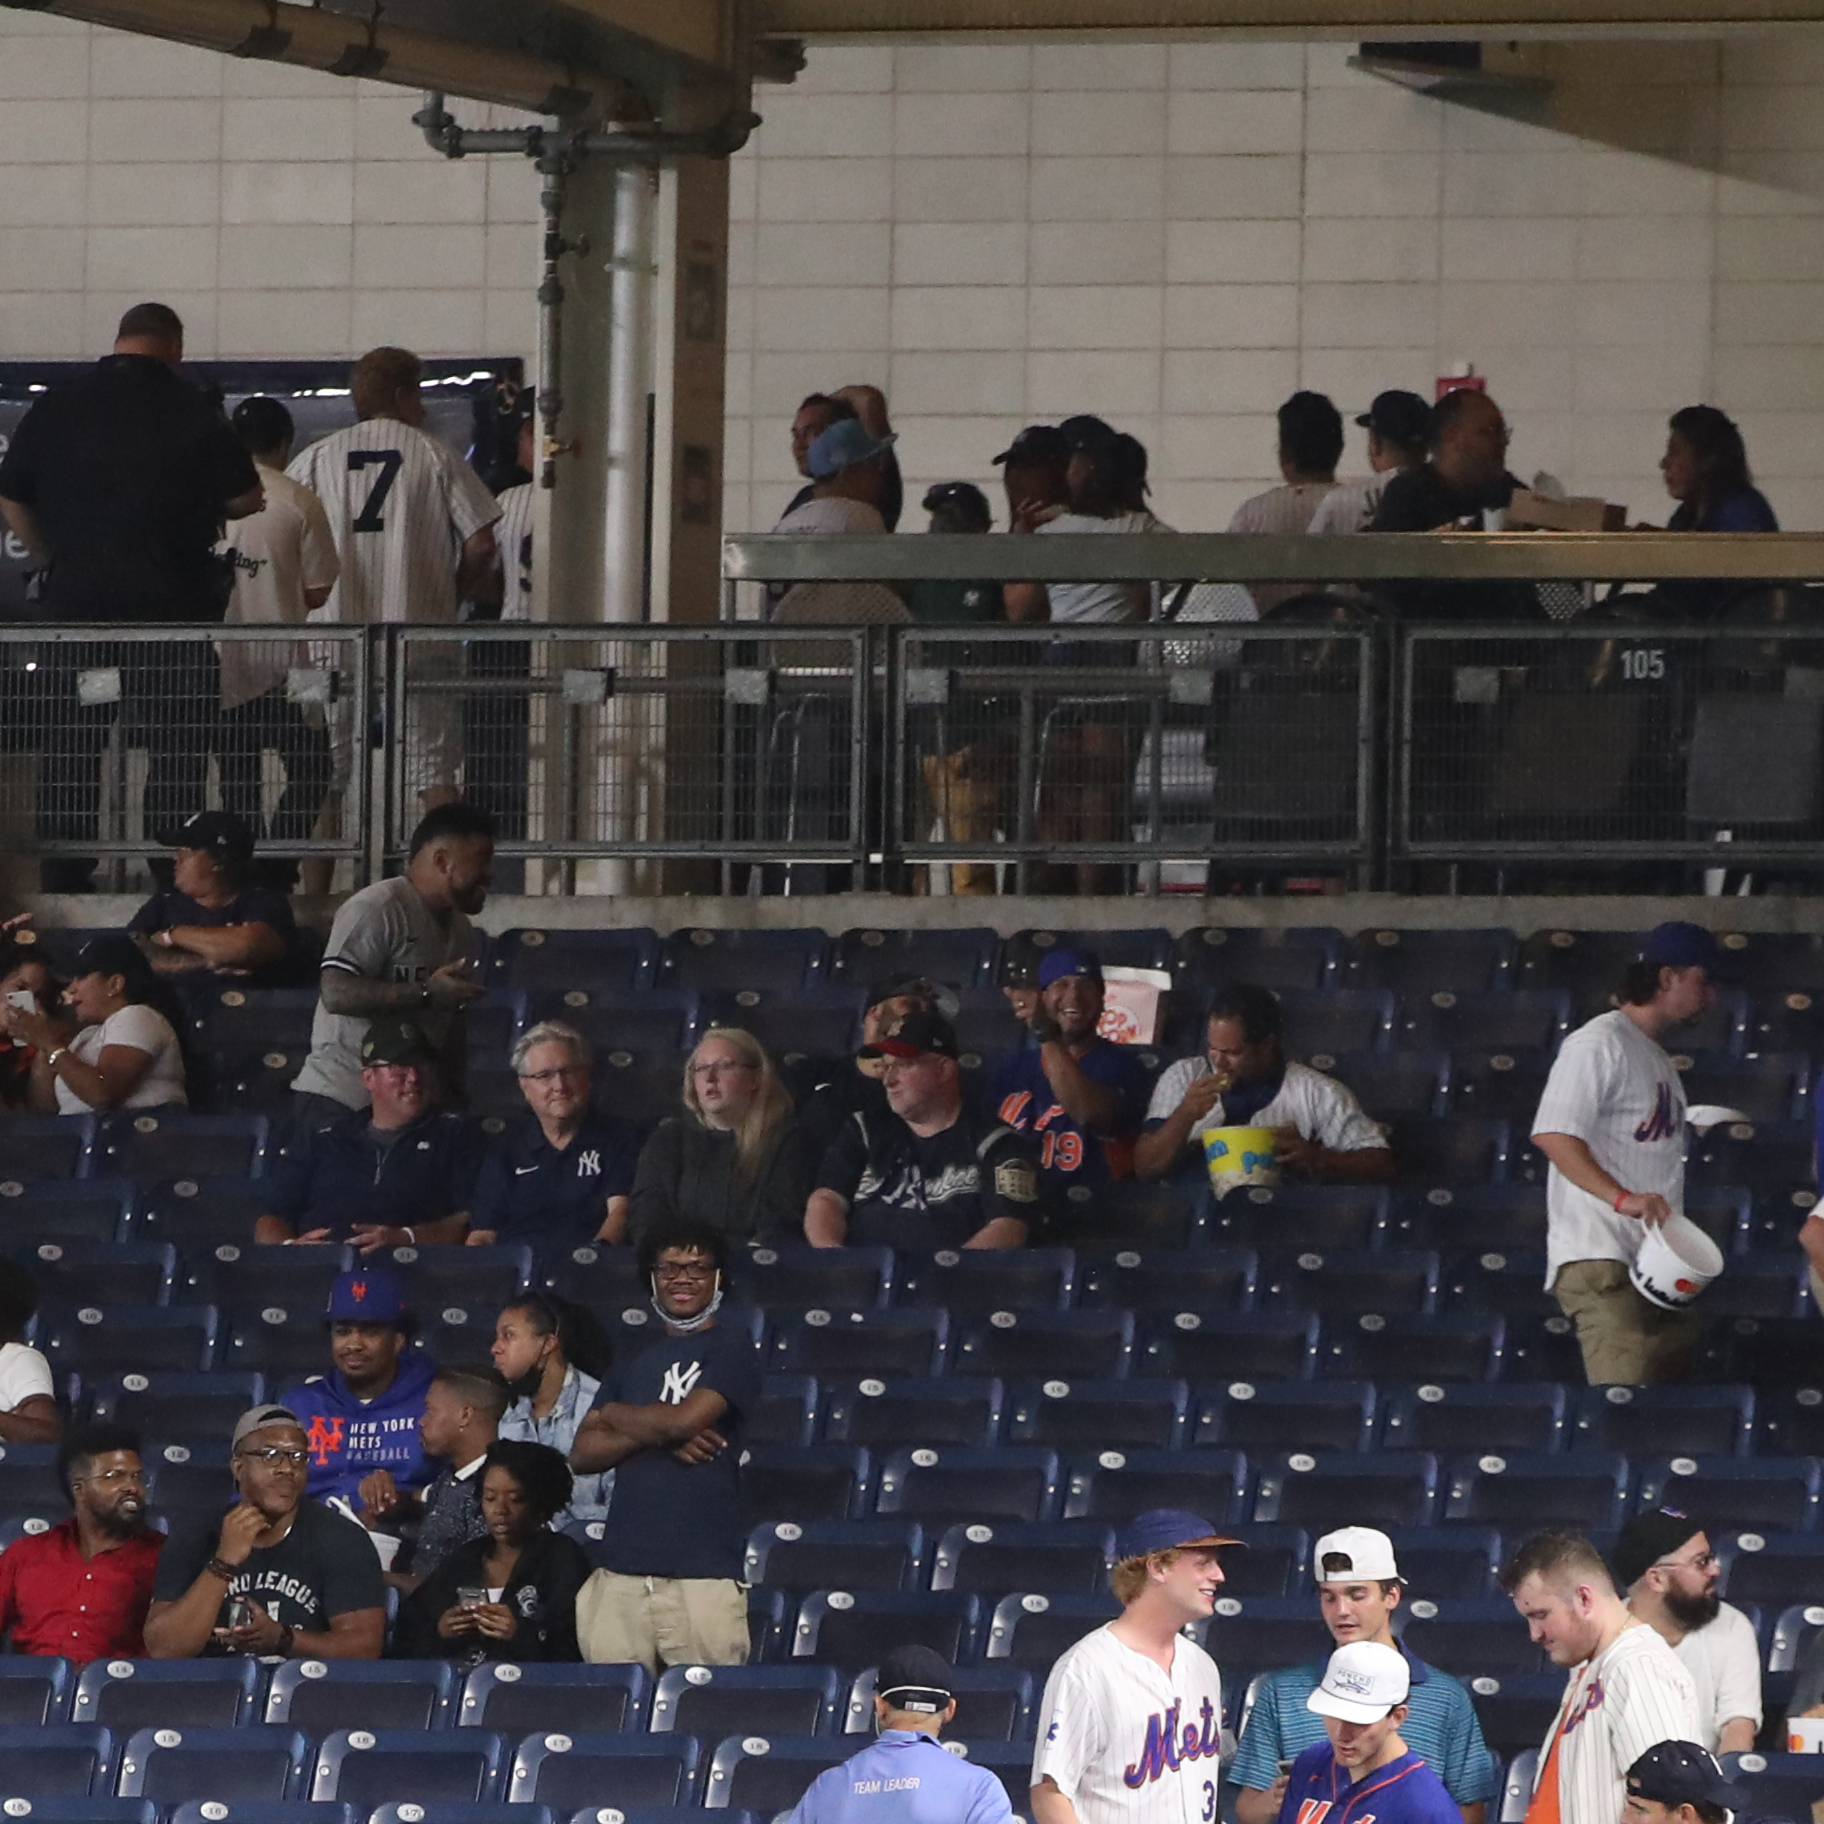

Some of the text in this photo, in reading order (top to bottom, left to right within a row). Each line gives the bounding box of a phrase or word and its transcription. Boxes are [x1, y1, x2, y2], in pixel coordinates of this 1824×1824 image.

[347, 449, 404, 533] 7
[1619, 649, 1665, 680] 105
[1040, 1131, 1084, 1171] 19
[658, 1361, 703, 1405] NY
[349, 1417, 416, 1437] NEW YORK
[348, 1436, 382, 1450] METS
[254, 1570, 320, 1615] LEAGUE
[1337, 1668, 1372, 1687] PONCHO
[853, 1776, 921, 1795] TEAM LEADER
